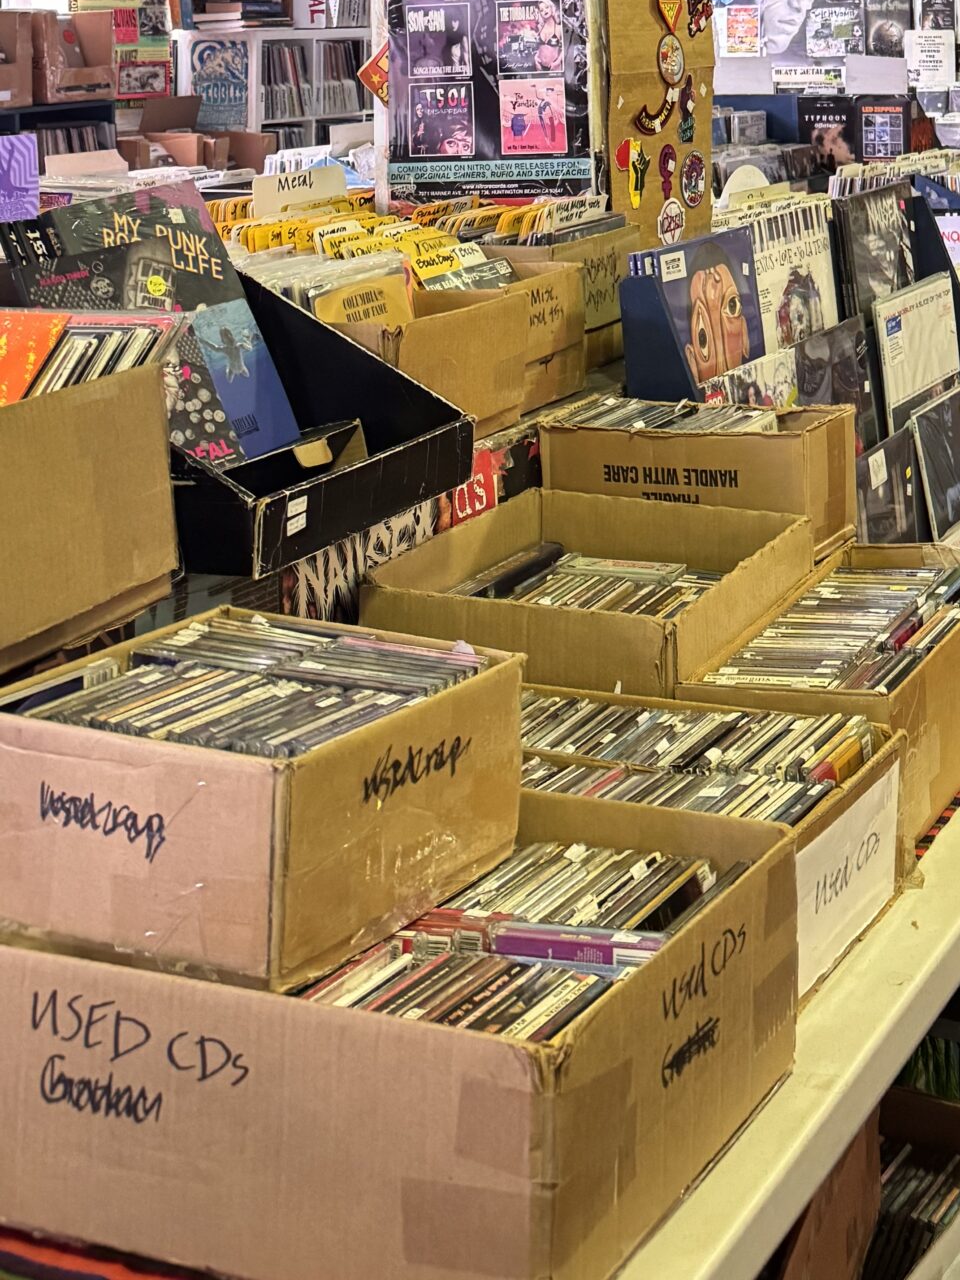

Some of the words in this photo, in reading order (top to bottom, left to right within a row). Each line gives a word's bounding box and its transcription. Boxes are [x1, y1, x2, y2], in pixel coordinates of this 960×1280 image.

[804, 114, 847, 122] TYPHOON
[397, 164, 427, 173] COMING
[429, 163, 453, 173] SOON
[454, 163, 466, 172] ON
[494, 162, 513, 171] NEW
[514, 161, 555, 171] RELEASES
[489, 170, 513, 179] RUFIO
[516, 170, 533, 178] AND
[278, 171, 314, 193] Metal
[113, 211, 142, 236] MY
[155, 224, 210, 257] PUNK
[169, 248, 225, 280] LIFE
[603, 464, 639, 484] CARE
[643, 466, 679, 485] WITH
[683, 468, 739, 488] HANDLE
[709, 922, 747, 978] CDs
[31, 989, 151, 1062] USED
[166, 1031, 249, 1087] CDs
